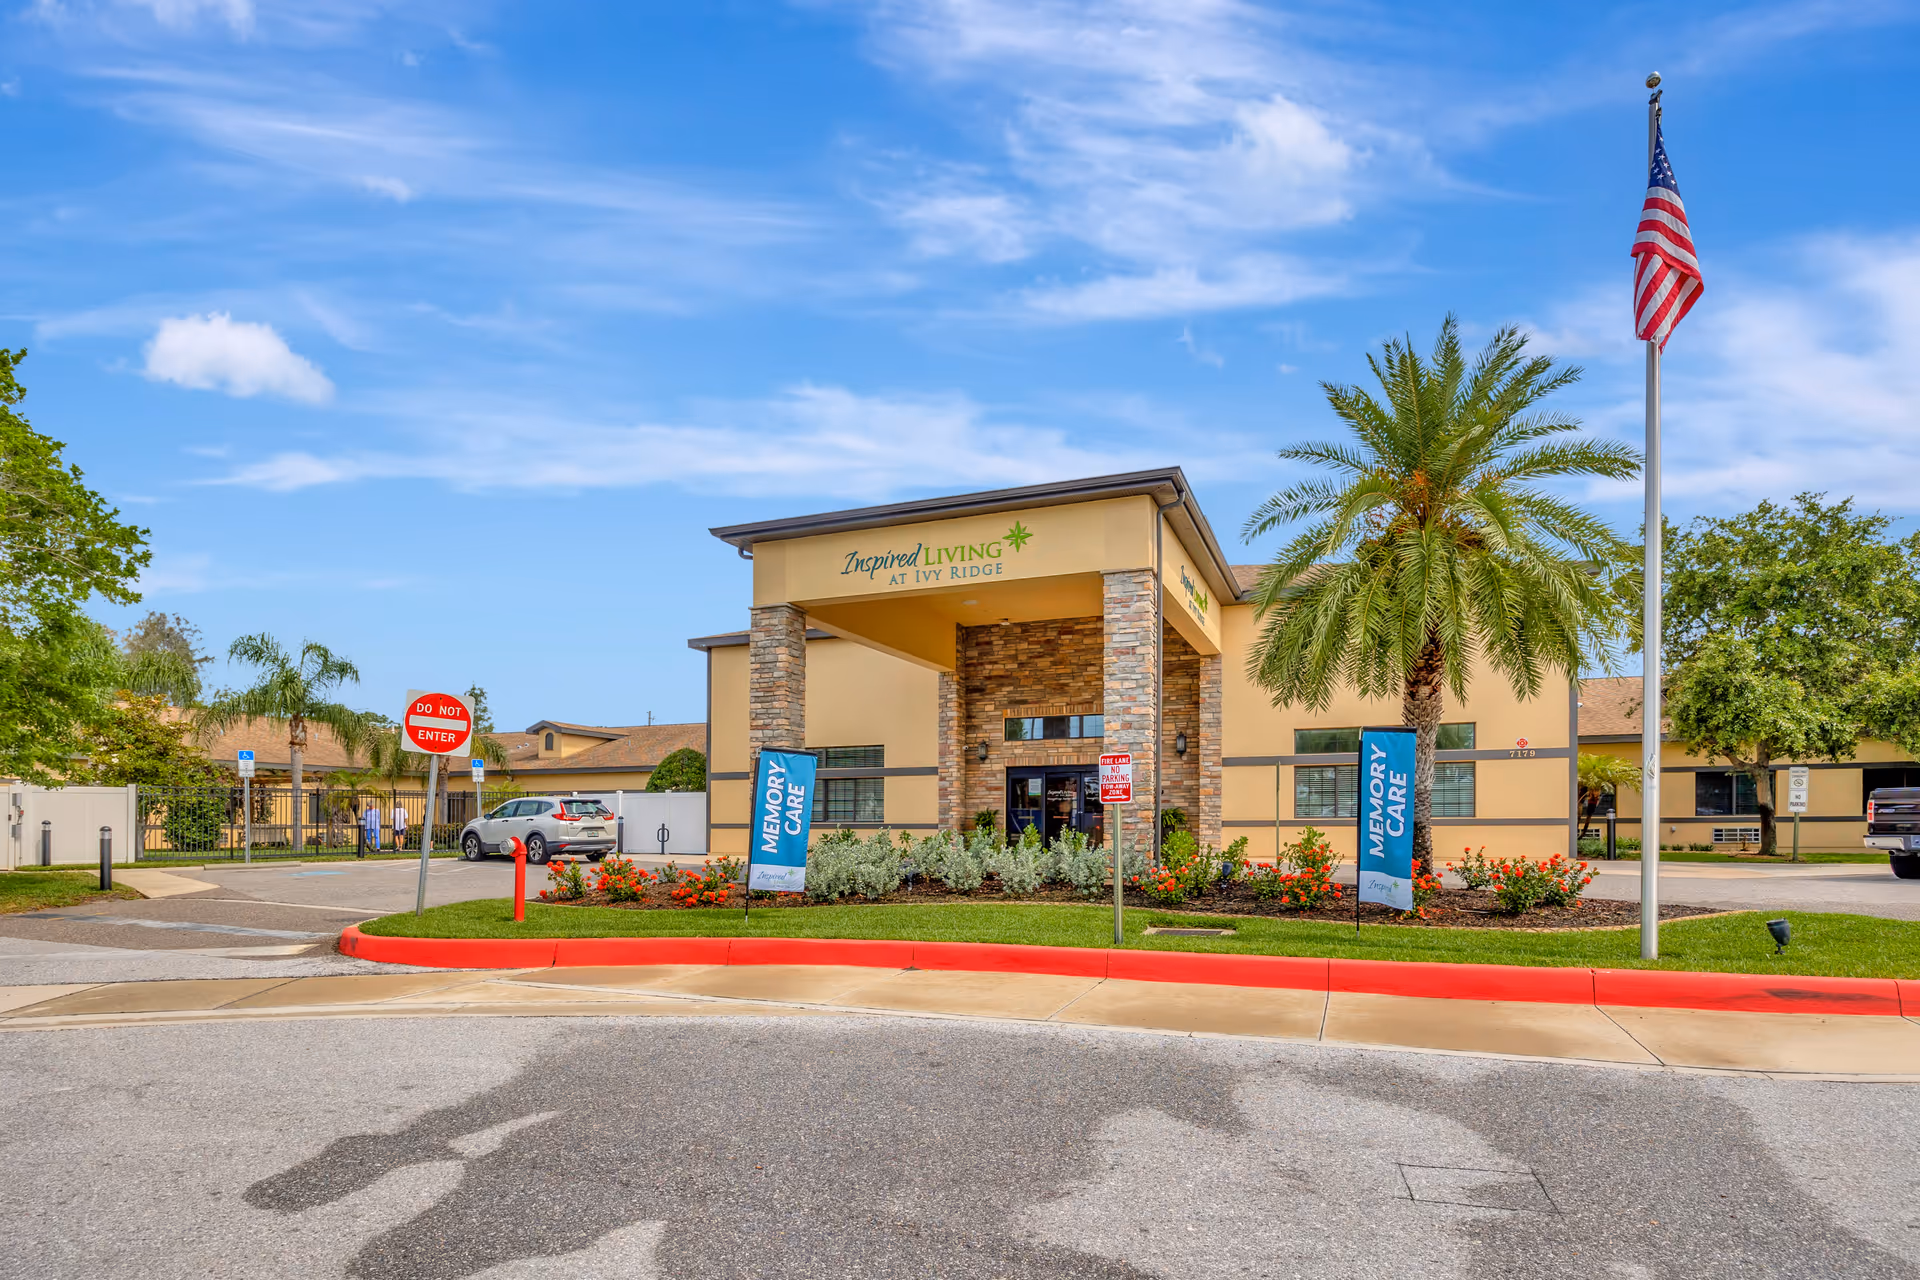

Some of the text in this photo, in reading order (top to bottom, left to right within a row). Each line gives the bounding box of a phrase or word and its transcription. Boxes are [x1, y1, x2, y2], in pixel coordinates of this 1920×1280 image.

[840, 541, 1003, 580] Inspired LIVING
[888, 563, 1003, 585] AT IVY RIDGE
[416, 702, 462, 717] DO NOT
[418, 729, 456, 743] ENTER
[1510, 750, 1536, 758] 7179
[1101, 774, 1130, 783] PARKING
[1110, 766, 1120, 774] NO
[761, 760, 786, 854] MEMORY
[784, 783, 806, 836] CARE
[1369, 742, 1387, 859] MEMORY
[1386, 770, 1407, 838] CARE
